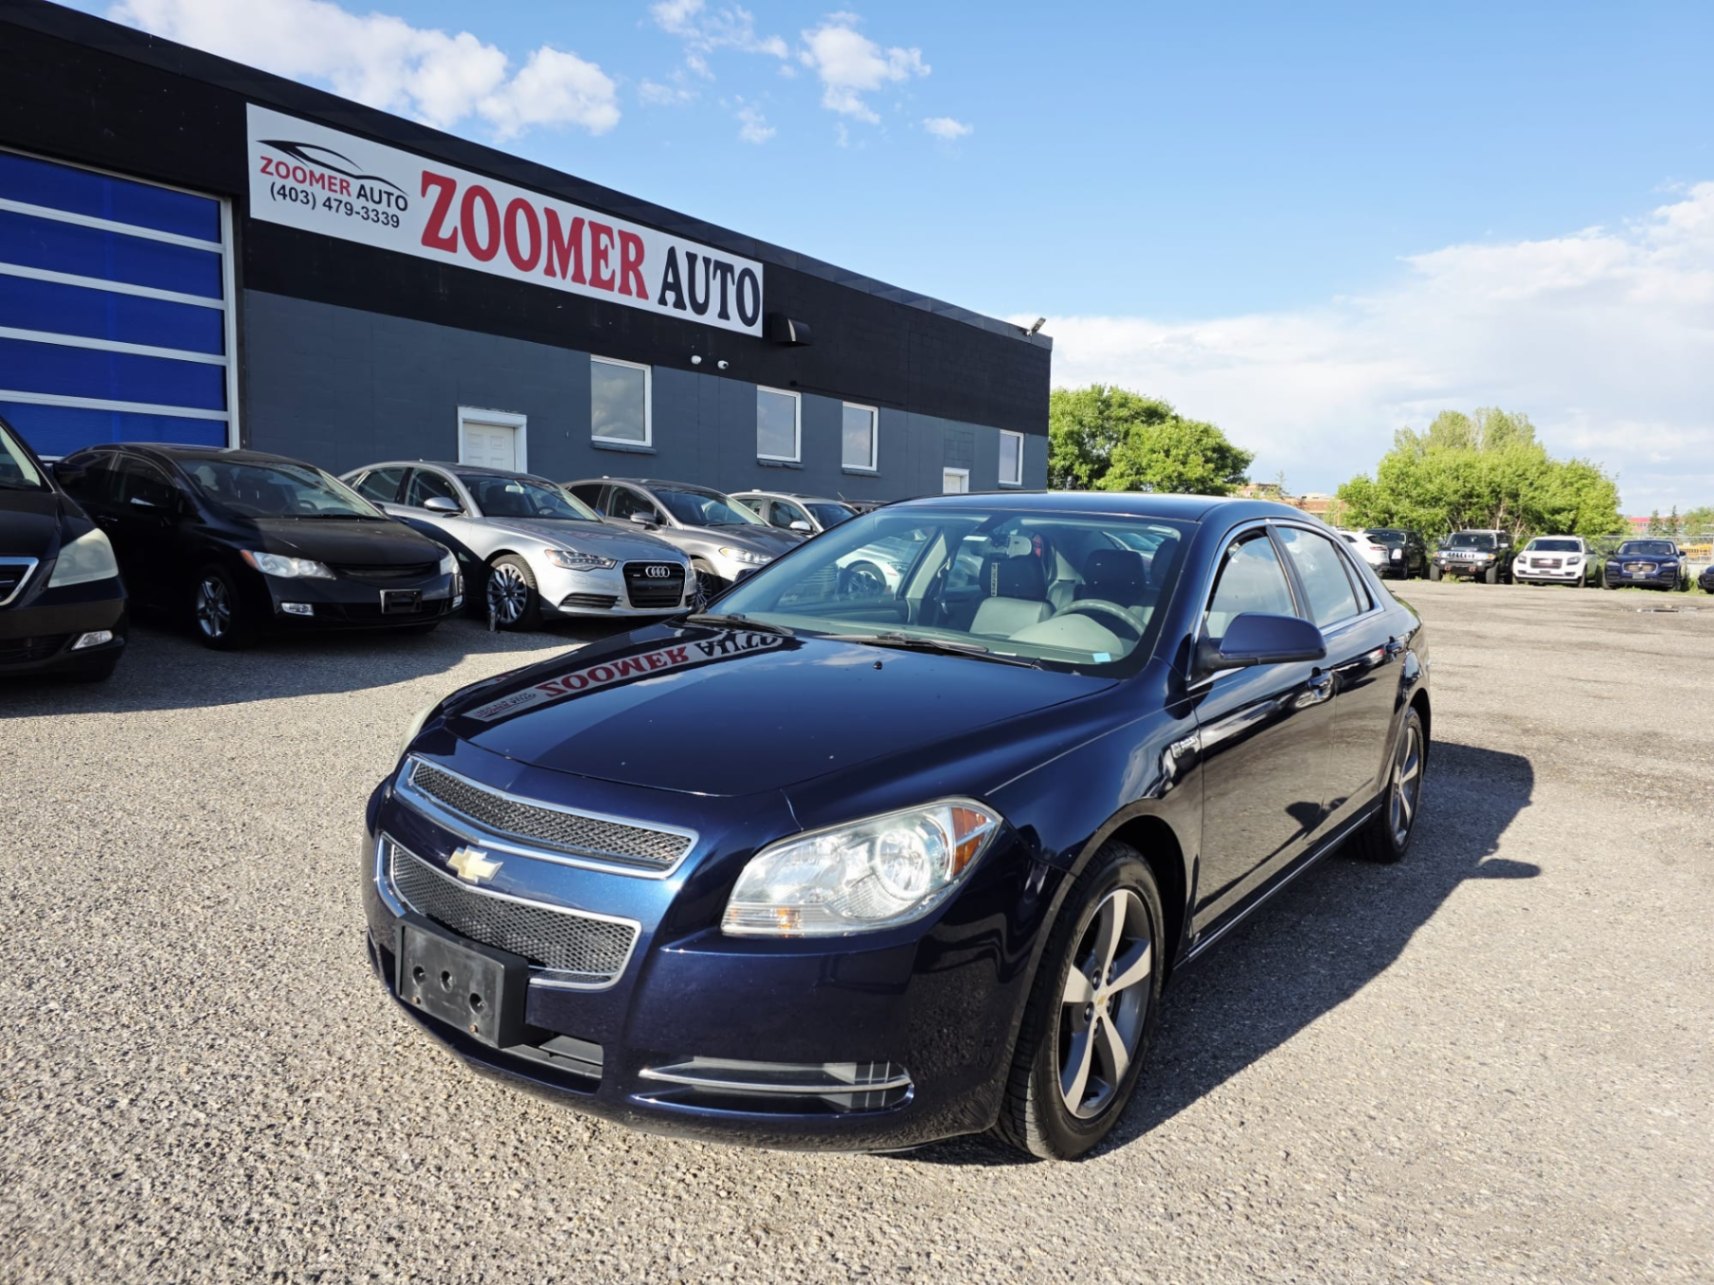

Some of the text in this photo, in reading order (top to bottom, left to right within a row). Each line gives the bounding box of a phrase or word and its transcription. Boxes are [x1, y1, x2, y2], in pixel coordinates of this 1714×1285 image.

[260, 156, 409, 212] ZOOMER AUTO
[270, 181, 401, 229] (403) 479-3339
[420, 170, 761, 328] ZOOMER AUTO
